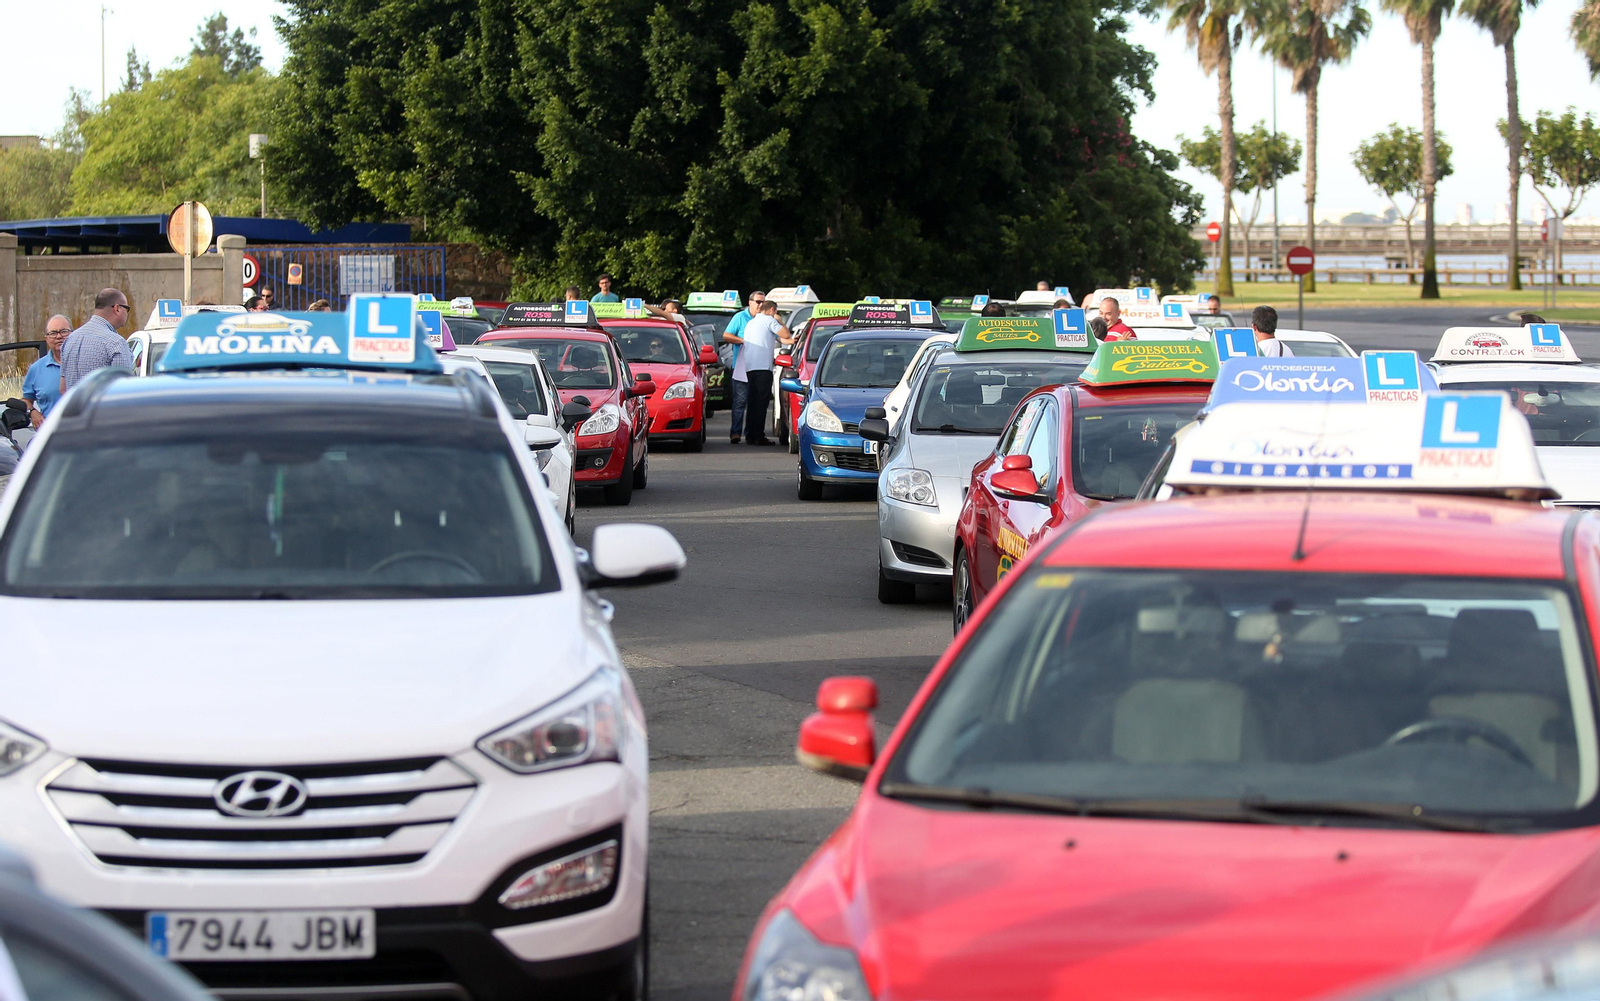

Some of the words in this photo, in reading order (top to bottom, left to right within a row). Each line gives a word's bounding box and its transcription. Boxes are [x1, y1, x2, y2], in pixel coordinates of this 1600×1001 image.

[244, 262, 253, 278] 0
[726, 292, 733, 300] L
[1139, 289, 1148, 298] L
[1200, 294, 1208, 302] L
[163, 302, 176, 316] L
[571, 302, 583, 314] L
[629, 300, 638, 309] L
[915, 303, 927, 314] L
[818, 308, 851, 317] VALVERD
[1119, 308, 1160, 319] Morga
[1167, 305, 1179, 317] L
[367, 301, 399, 334] L
[977, 319, 1038, 327] AUTOESCUELA
[1062, 313, 1078, 331] L
[1057, 334, 1086, 342] PRACTICAS
[1537, 327, 1554, 344] L
[183, 335, 342, 355] MOLINA
[354, 338, 411, 353] PRACTICAS
[1112, 345, 1204, 355] AUTOESCUELA
[1224, 333, 1248, 357] L
[1533, 345, 1562, 353] PRACTICAS
[1376, 357, 1405, 385] L
[1369, 390, 1419, 402] PRACTICAS
[1439, 401, 1481, 444] L
[1420, 449, 1494, 468] PRACTICAS
[175, 918, 275, 951] 7944
[292, 917, 364, 950] JBM
